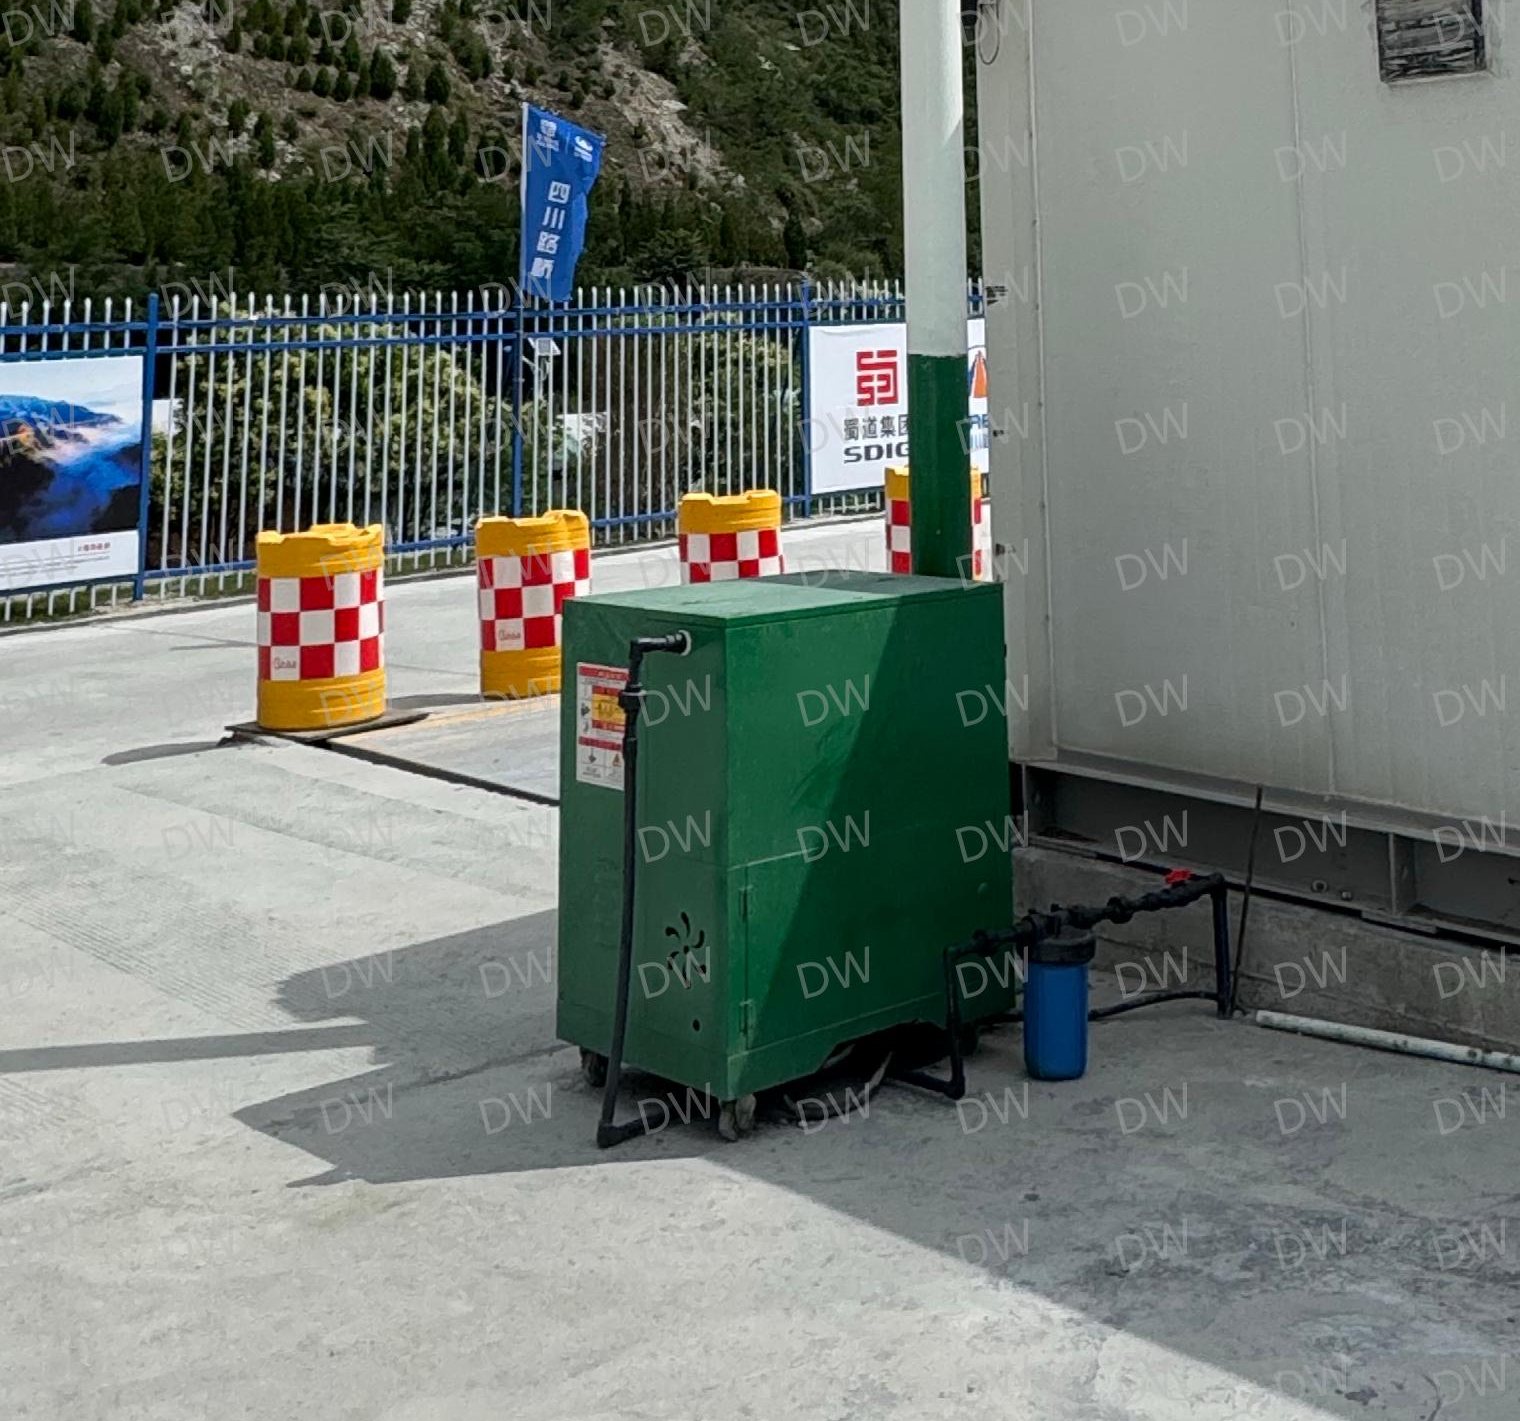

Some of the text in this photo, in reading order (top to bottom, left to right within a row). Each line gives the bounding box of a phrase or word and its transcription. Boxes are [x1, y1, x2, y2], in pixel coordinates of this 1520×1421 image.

[844, 414, 910, 441] 蜀道集团
[844, 441, 909, 464] SDIG
